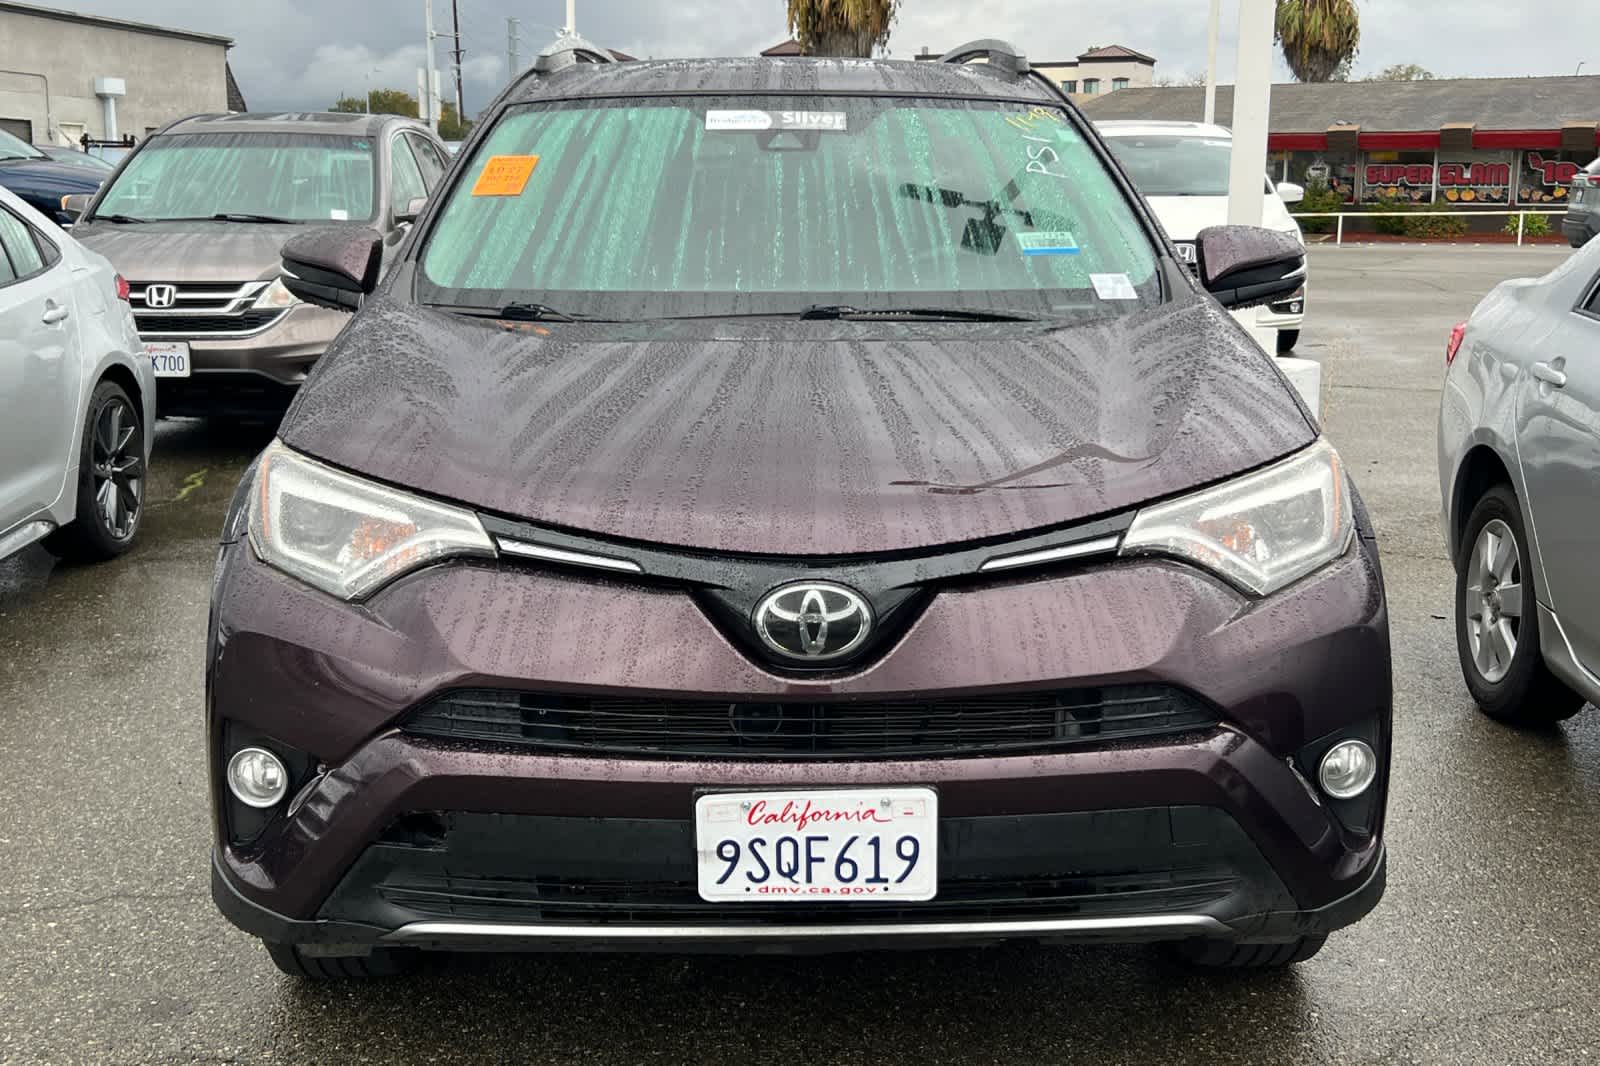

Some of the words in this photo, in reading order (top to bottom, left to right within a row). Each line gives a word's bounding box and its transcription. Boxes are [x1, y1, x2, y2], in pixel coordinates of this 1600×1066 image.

[781, 111, 844, 126] Silver
[1366, 165, 1434, 186] SUPER
[1439, 163, 1510, 187] SLAM
[147, 355, 185, 371] K700
[748, 800, 892, 831] California
[716, 835, 920, 884] 9SQF619
[758, 885, 877, 894] dmv.ca.gov
